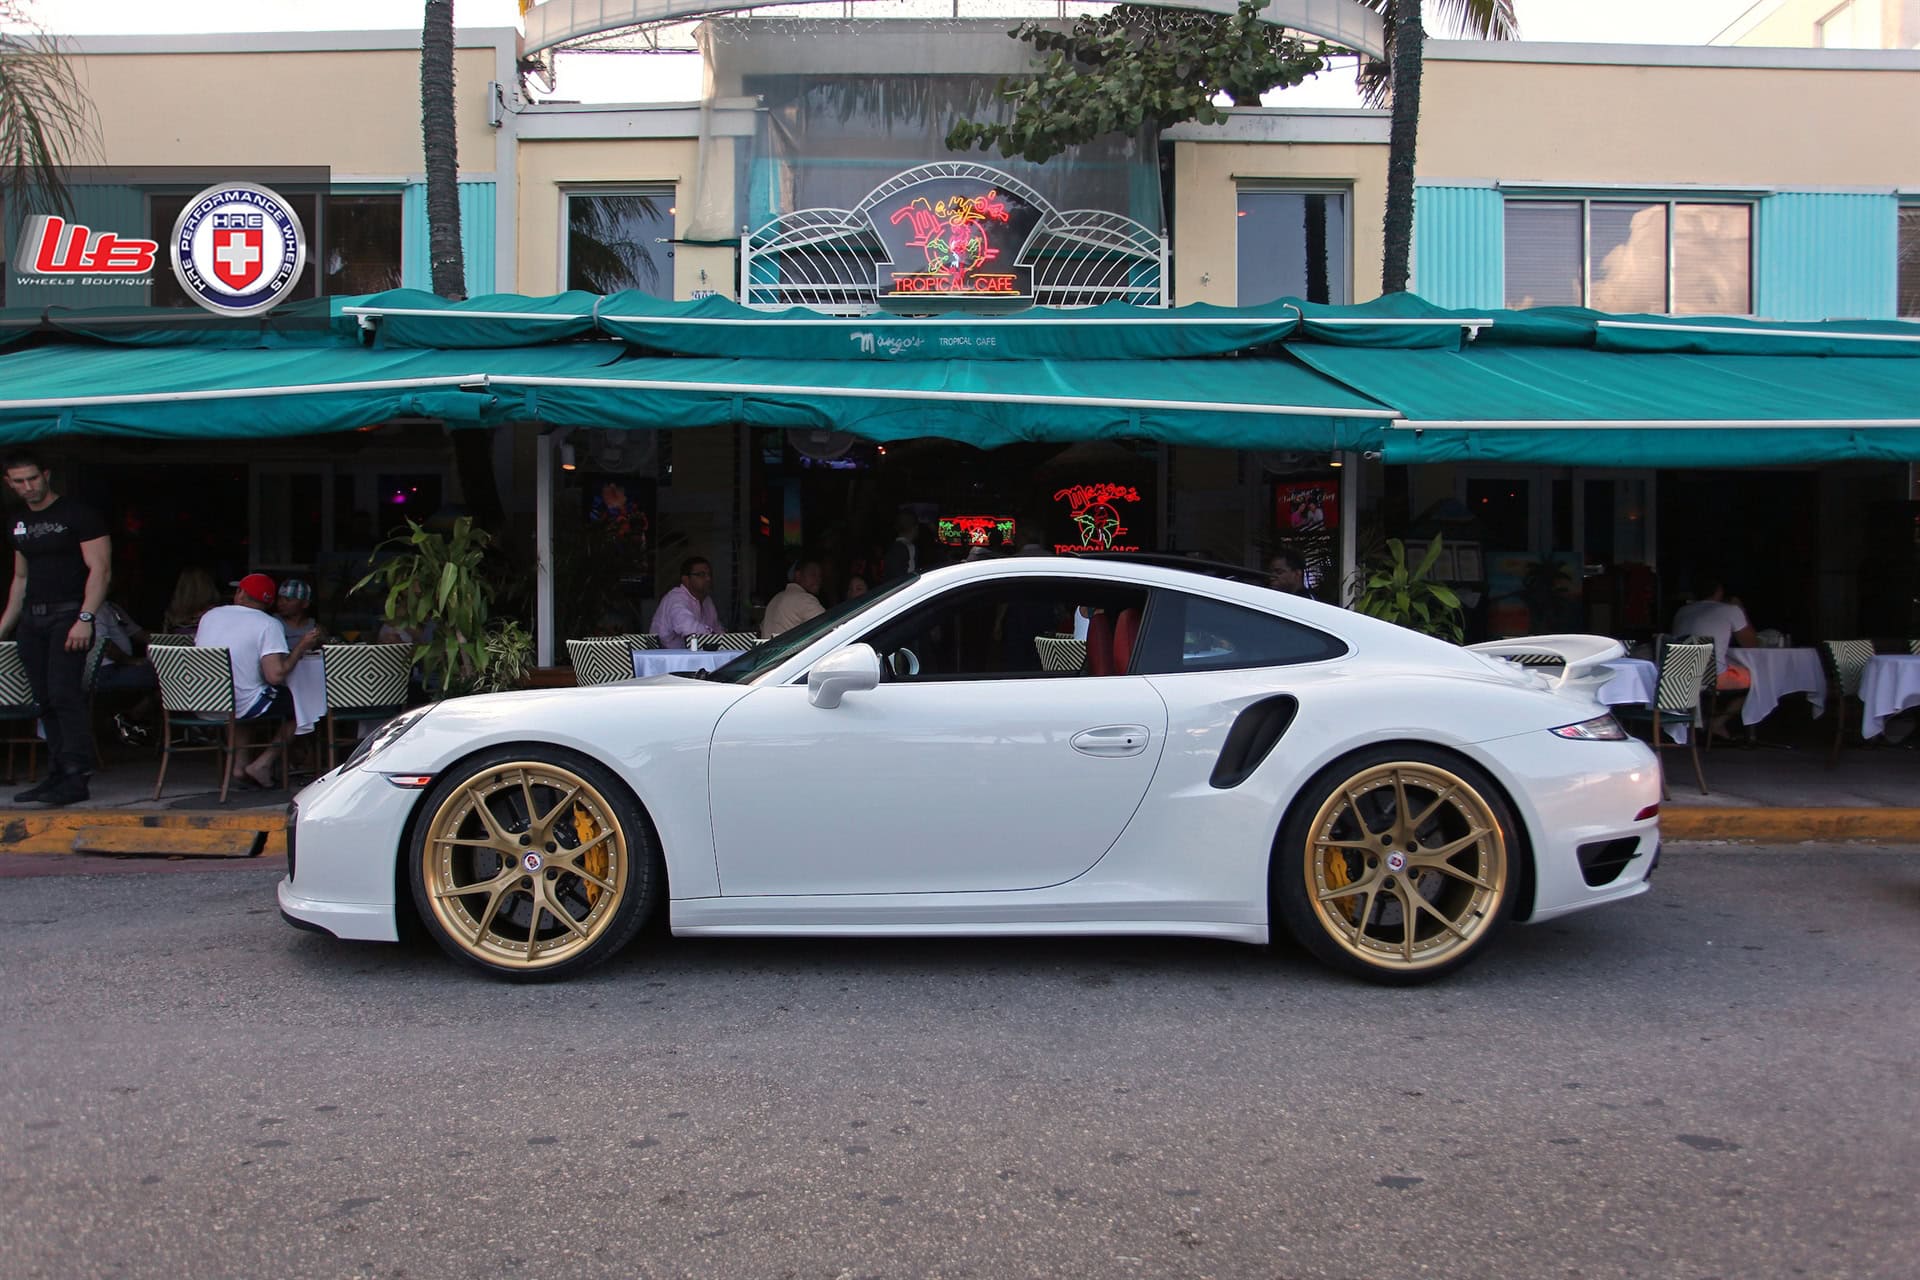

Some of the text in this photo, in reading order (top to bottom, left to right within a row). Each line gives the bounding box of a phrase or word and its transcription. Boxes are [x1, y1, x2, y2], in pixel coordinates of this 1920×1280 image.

[893, 277, 1013, 291] TROPICAL CAFE
[850, 331, 997, 354] Mango's TROPICAL CAFE
